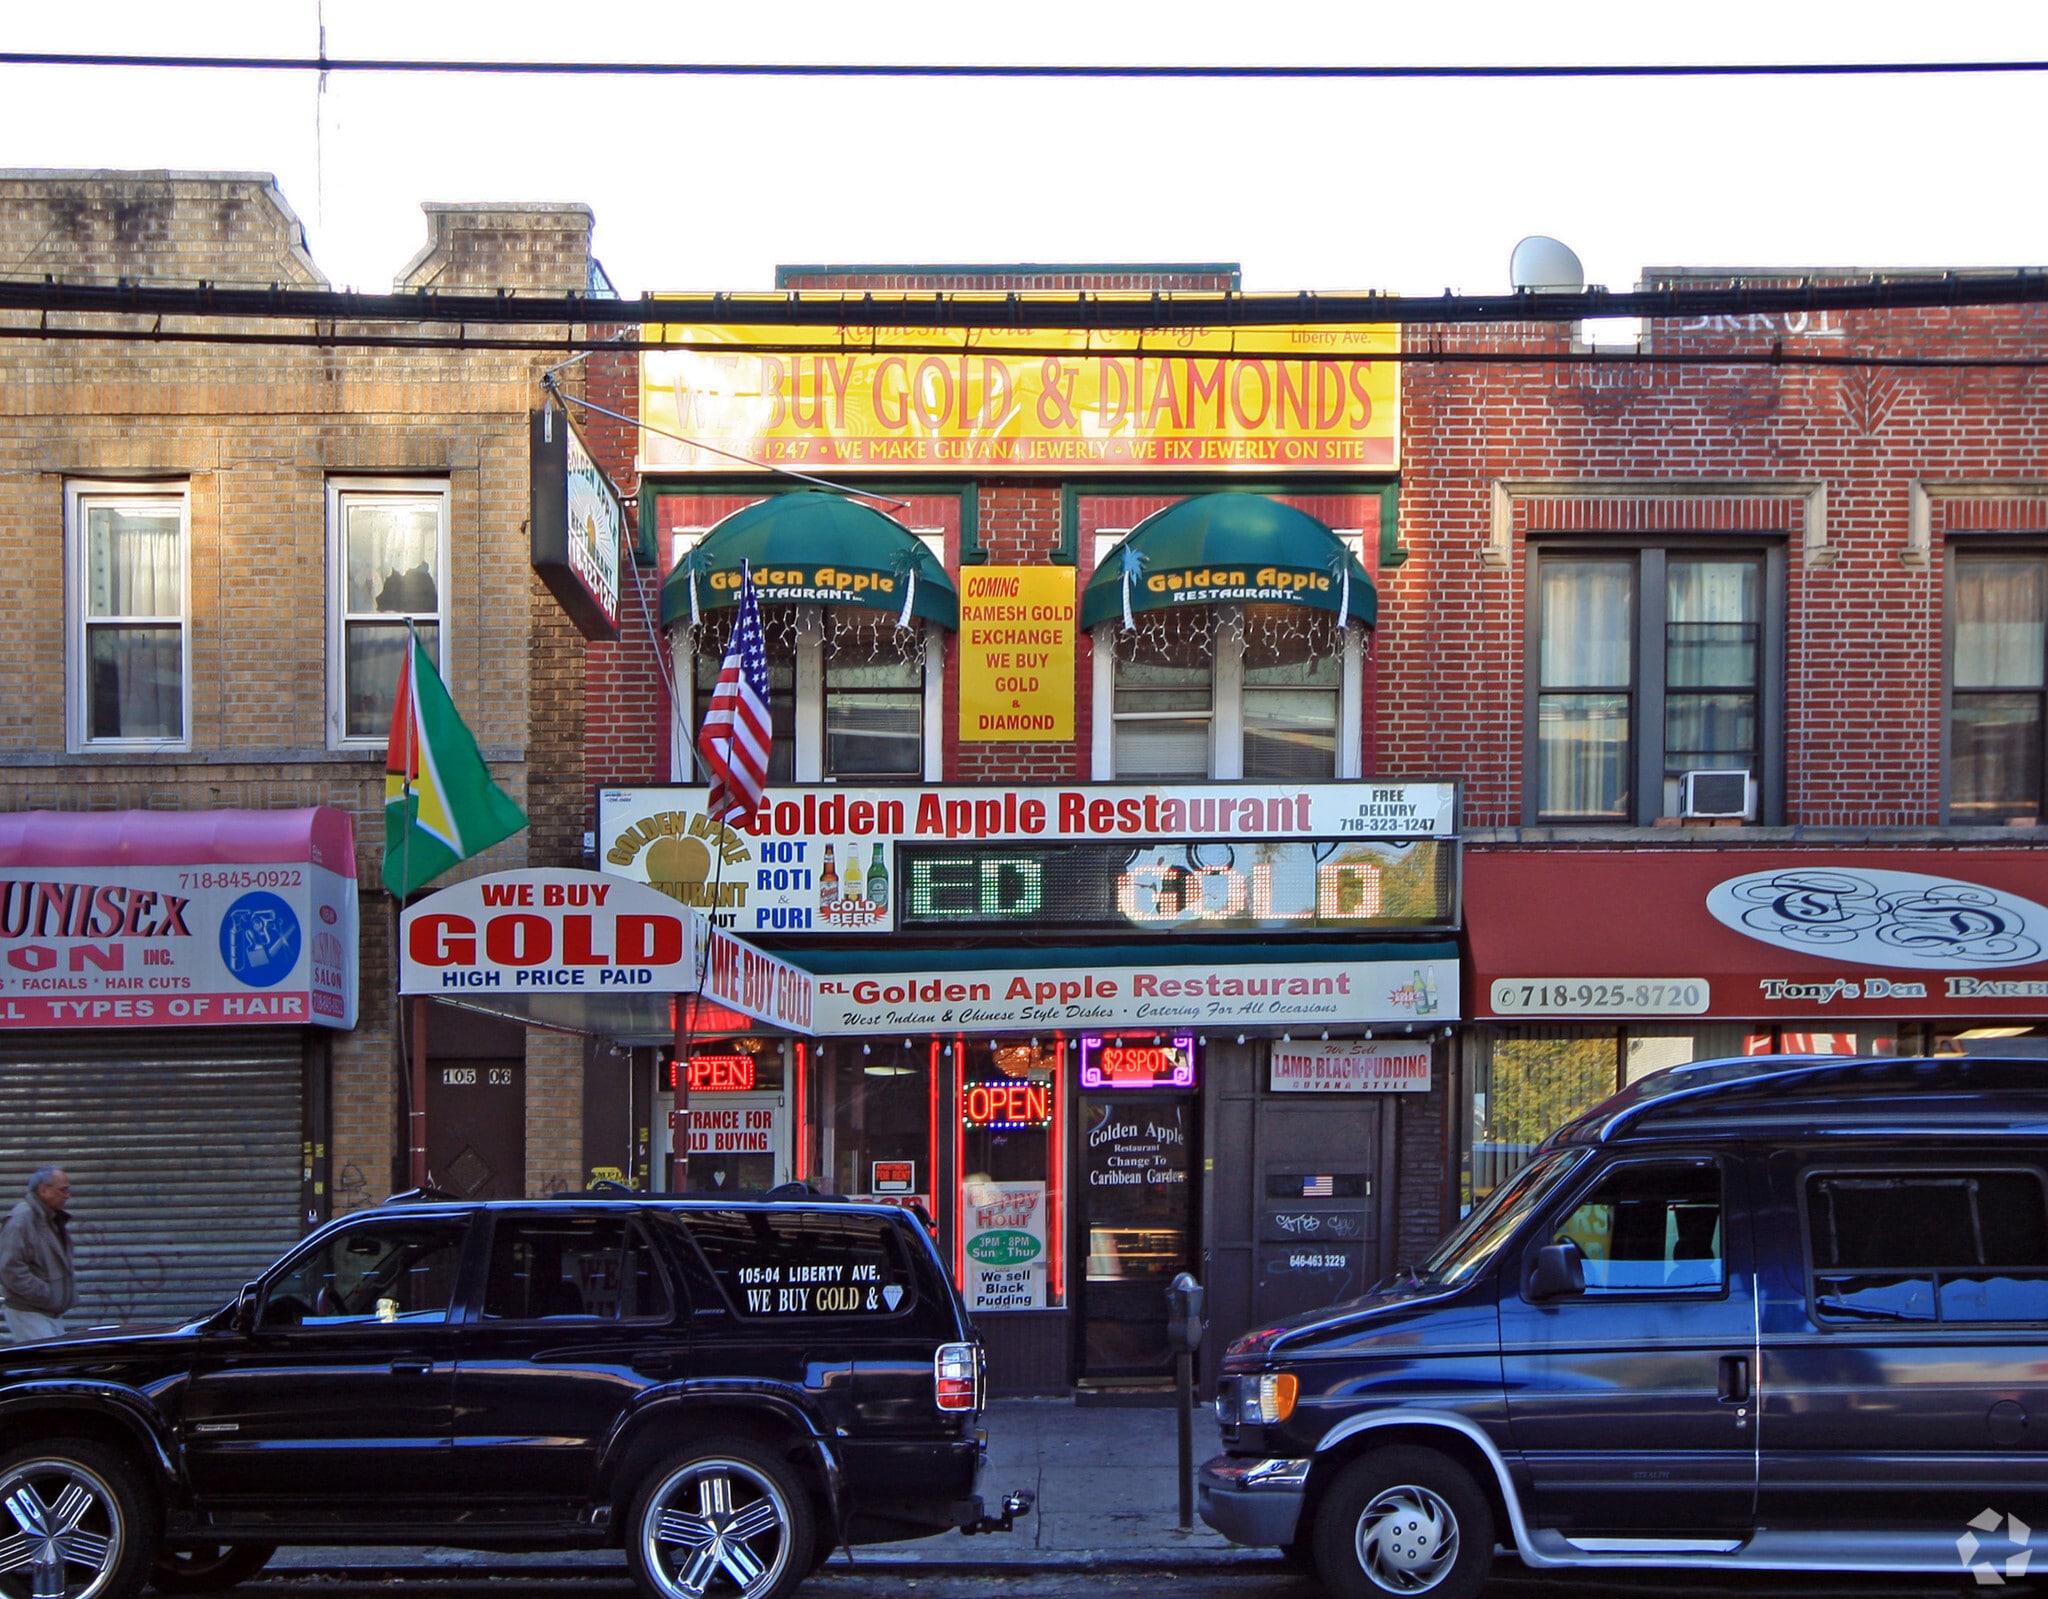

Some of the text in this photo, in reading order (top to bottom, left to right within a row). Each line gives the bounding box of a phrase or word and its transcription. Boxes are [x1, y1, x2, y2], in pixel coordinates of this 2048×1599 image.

[1291, 330, 1371, 345] Liberty Ave.
[761, 357, 857, 430] BUY
[873, 356, 1013, 430] GOLD
[1037, 355, 1079, 429] &
[1098, 357, 1373, 430] DIAMONDS
[834, 441, 865, 459] WE
[870, 441, 927, 459] MAKE
[935, 441, 1020, 460] GUYANA
[1029, 441, 1110, 459] JEWERLY
[1130, 441, 1157, 459] WE
[1164, 441, 1193, 459] FIX
[1199, 441, 1283, 459] JEWERLY
[1285, 441, 1318, 459] ON
[1325, 441, 1365, 459] SITE
[570, 509, 614, 587] RESTRANT
[710, 568, 894, 592] Goden Apple
[968, 577, 1020, 598] COMING
[1147, 568, 1330, 592] Golden Apple
[734, 588, 854, 601] RSTAURANT
[1174, 588, 1294, 601] RESTAURANT
[962, 606, 1073, 621] RAMESH GOLD
[972, 630, 1063, 645] EXCHANGE
[986, 653, 1049, 668] WE BUY
[995, 677, 1039, 692] GOLD
[1012, 700, 1020, 708] &
[979, 715, 1055, 730] DIAMOND
[1372, 790, 1404, 802] FREE
[745, 793, 1313, 838] Golden Apple Restaurant
[1359, 804, 1417, 817] DELIVRY
[1340, 818, 1435, 831] 718-323-1247
[607, 811, 752, 866] GOLDEN APPLE
[761, 842, 807, 863] HOT
[179, 870, 303, 890] 718-845-0922
[757, 869, 812, 890] ROTI
[481, 884, 611, 907] WE BUY
[638, 882, 749, 907] AURANT
[912, 858, 1382, 921] ED GOLD
[778, 895, 791, 904] &
[829, 900, 877, 912] COLD
[0, 881, 192, 938] UNISEX
[756, 908, 812, 928] PURI
[829, 912, 876, 924] BEER
[409, 914, 683, 966] GOLD
[144, 949, 174, 965] INC.
[22, 977, 191, 990] FACIALS HAIR CUTS
[314, 967, 342, 989] SALON
[442, 969, 653, 987] HIGH PRICE PAID
[710, 931, 739, 1003] WE
[743, 948, 775, 1016] BUY
[777, 965, 812, 1028] GOLD
[819, 972, 1350, 1005] RL Golden Apple Restaurant
[1520, 985, 1700, 1007] 718-925-8720
[1760, 976, 2048, 1004] Tony's Den BARB
[48, 1000, 154, 1019] TYPES
[168, 999, 210, 1017] OF
[223, 997, 303, 1016] HAIR
[842, 1000, 1338, 1026] West Indian & Chinese Style Dishes Catering For All Occasions
[1323, 1045, 1378, 1054] We Sell
[1104, 1050, 1168, 1075] $2 SPOT
[1274, 1054, 1428, 1079] LAMB BLACK PUDDING
[443, 1069, 511, 1084] 105 06
[687, 1061, 749, 1086] PEN
[969, 1087, 1046, 1120] OPEN
[668, 1111, 772, 1129] ETRANCE FOR
[672, 1132, 768, 1150] LD BUYING
[1090, 1122, 1184, 1147] Golden Apple
[1114, 1144, 1160, 1152] Restaurant
[1107, 1155, 1167, 1168] Change To
[1090, 1169, 1184, 1185] Caribbean Garden
[967, 1190, 1041, 1211] Happy
[976, 1209, 1032, 1229] Hour
[980, 1237, 1029, 1247] 3PM 8PM
[972, 1247, 1036, 1258] Sun Thur
[1289, 1255, 1346, 1267] 646-463 3229
[738, 1265, 881, 1284] 105-04 LIBERTY AVE.
[981, 1270, 1031, 1282] We sell
[985, 1283, 1024, 1294] Black
[747, 1286, 879, 1312] WE BUY GOLD &
[976, 1295, 1032, 1307] Pudding
